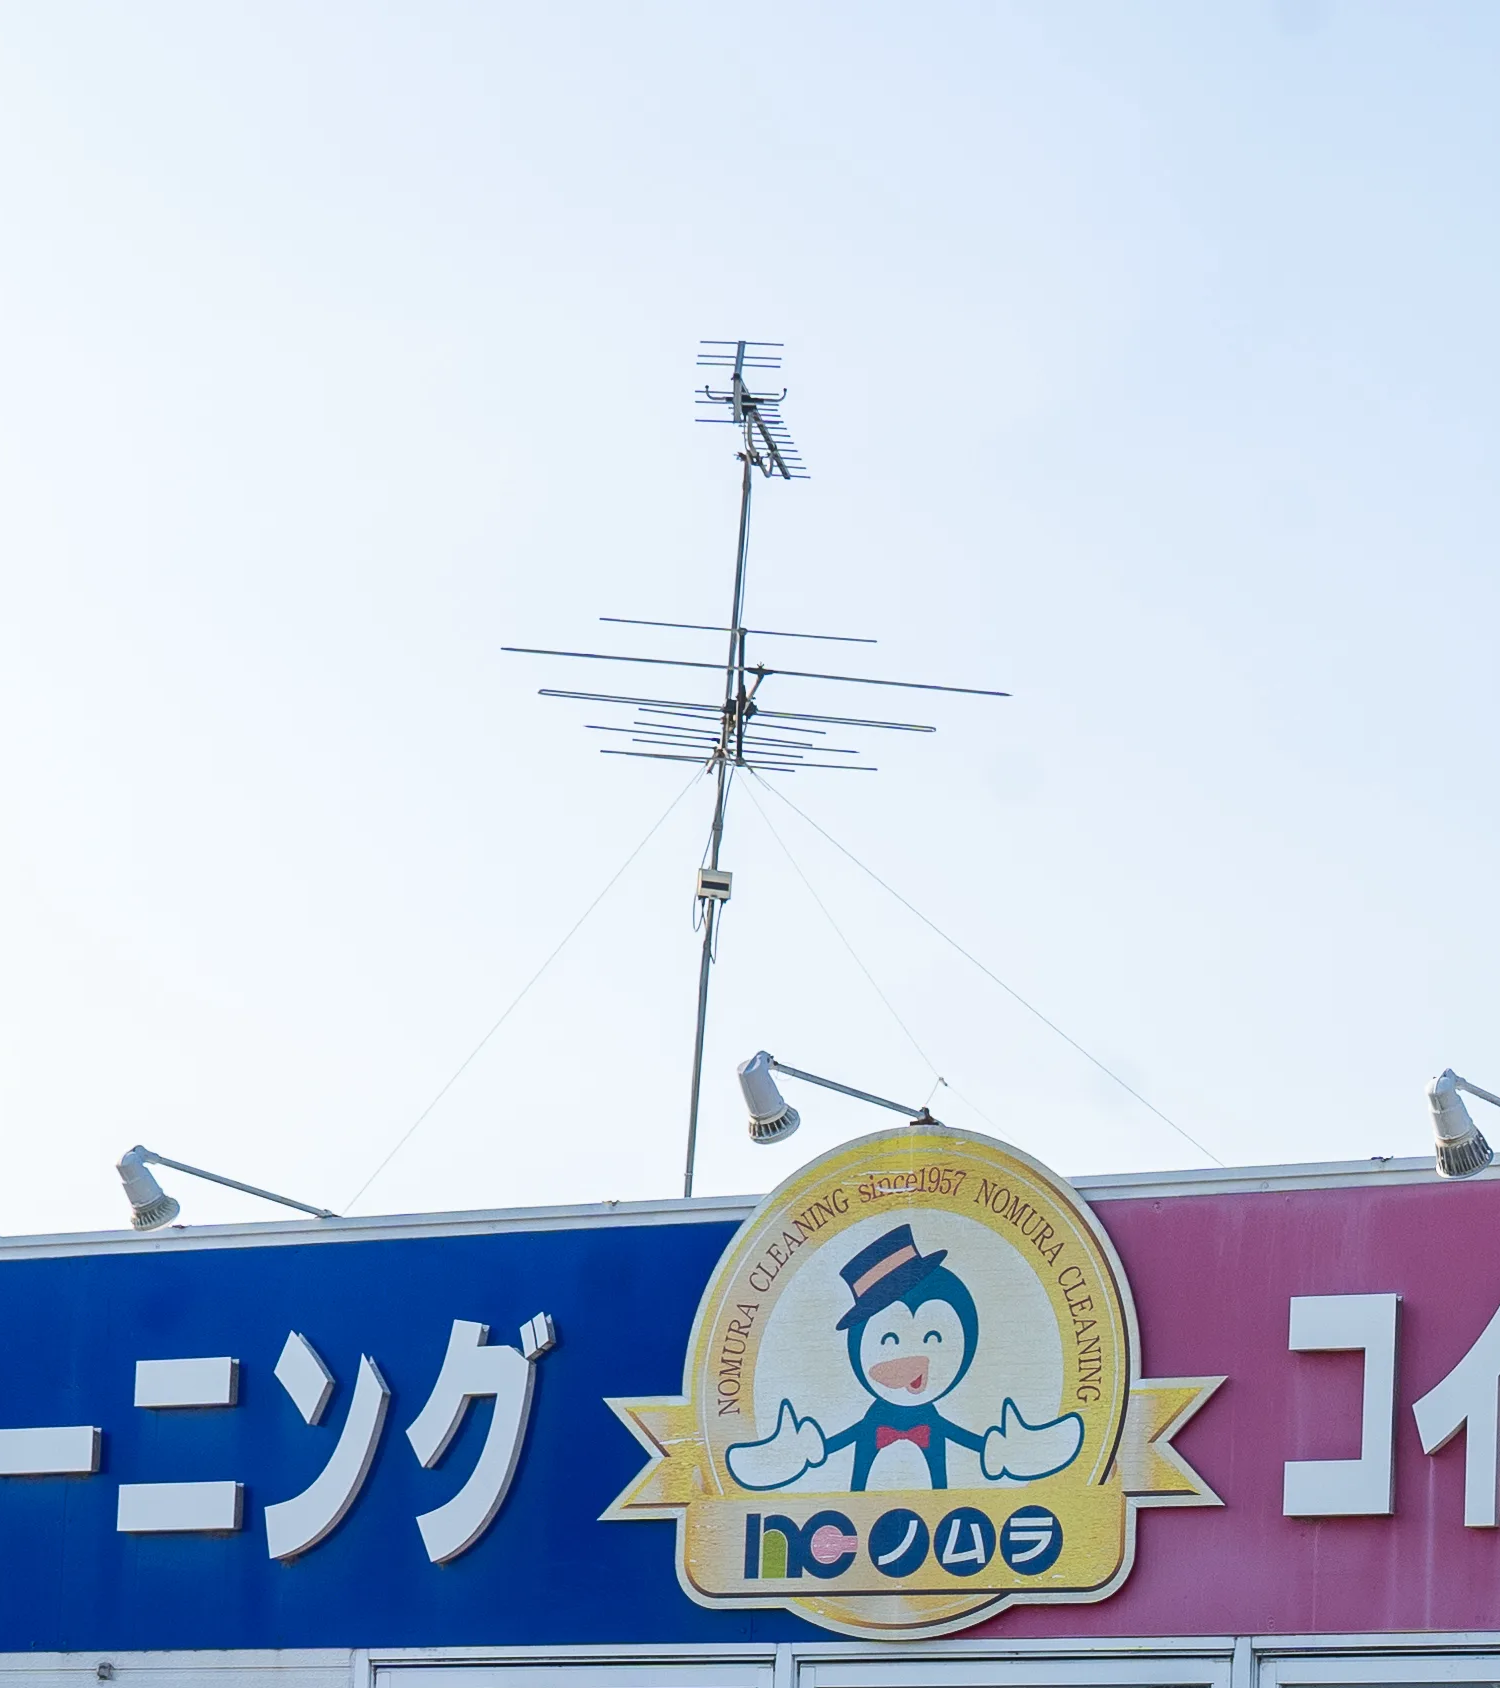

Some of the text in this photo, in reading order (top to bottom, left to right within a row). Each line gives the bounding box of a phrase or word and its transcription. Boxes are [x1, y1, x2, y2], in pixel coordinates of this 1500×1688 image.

[717, 1301, 760, 1416] NOMURA
[748, 1188, 849, 1293] CLEANING
[974, 1177, 1062, 1269] NOMURA
[1057, 1265, 1104, 1403] CLEANING
